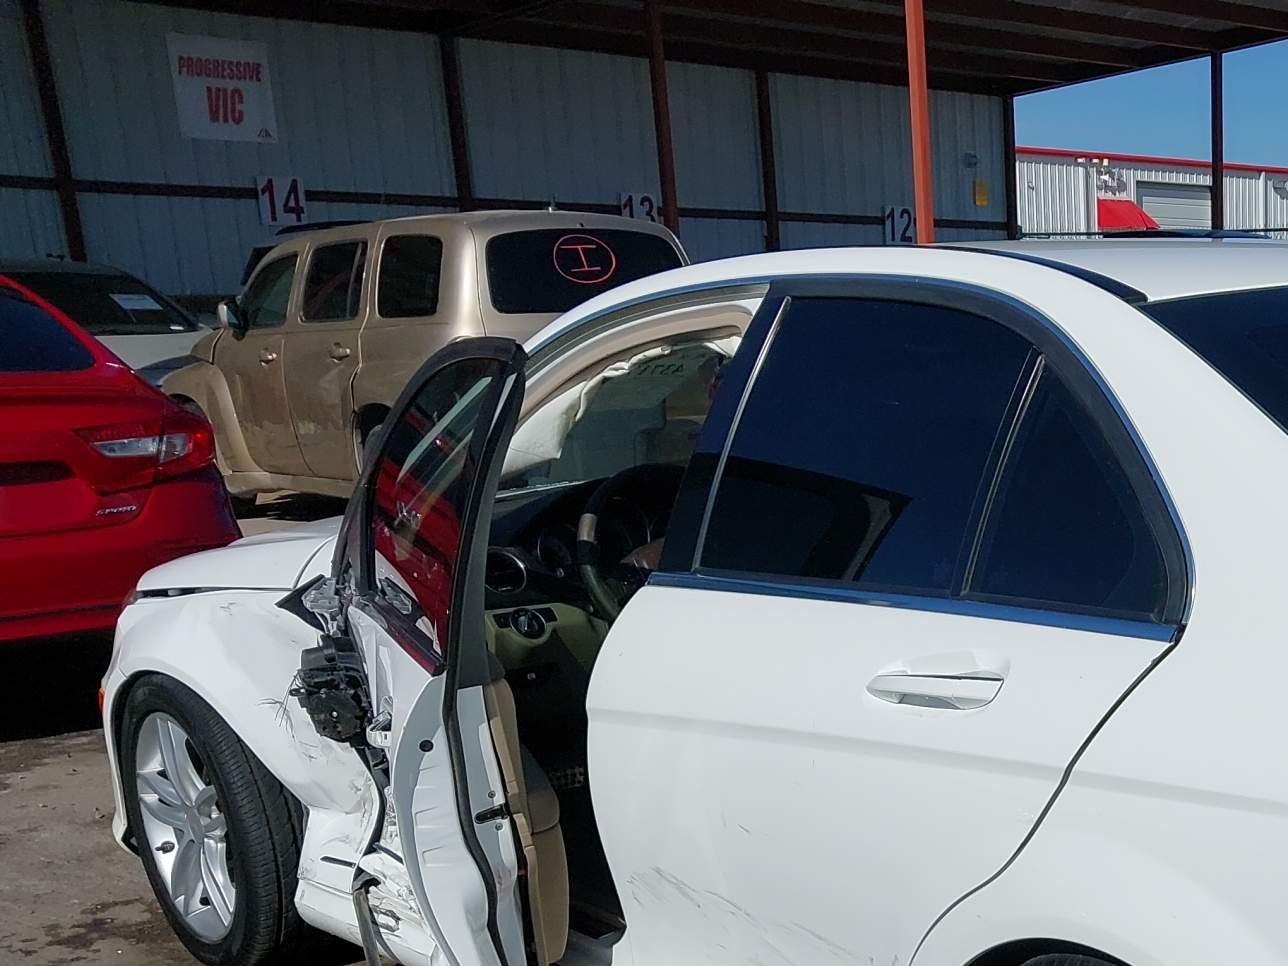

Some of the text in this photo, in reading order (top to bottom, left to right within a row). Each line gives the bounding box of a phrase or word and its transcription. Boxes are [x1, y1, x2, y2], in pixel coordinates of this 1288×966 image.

[177, 55, 263, 82] PROGRESSIVE
[206, 86, 244, 125] VIC
[260, 178, 305, 222] 14
[623, 194, 656, 222] 13
[886, 207, 913, 242] 12
